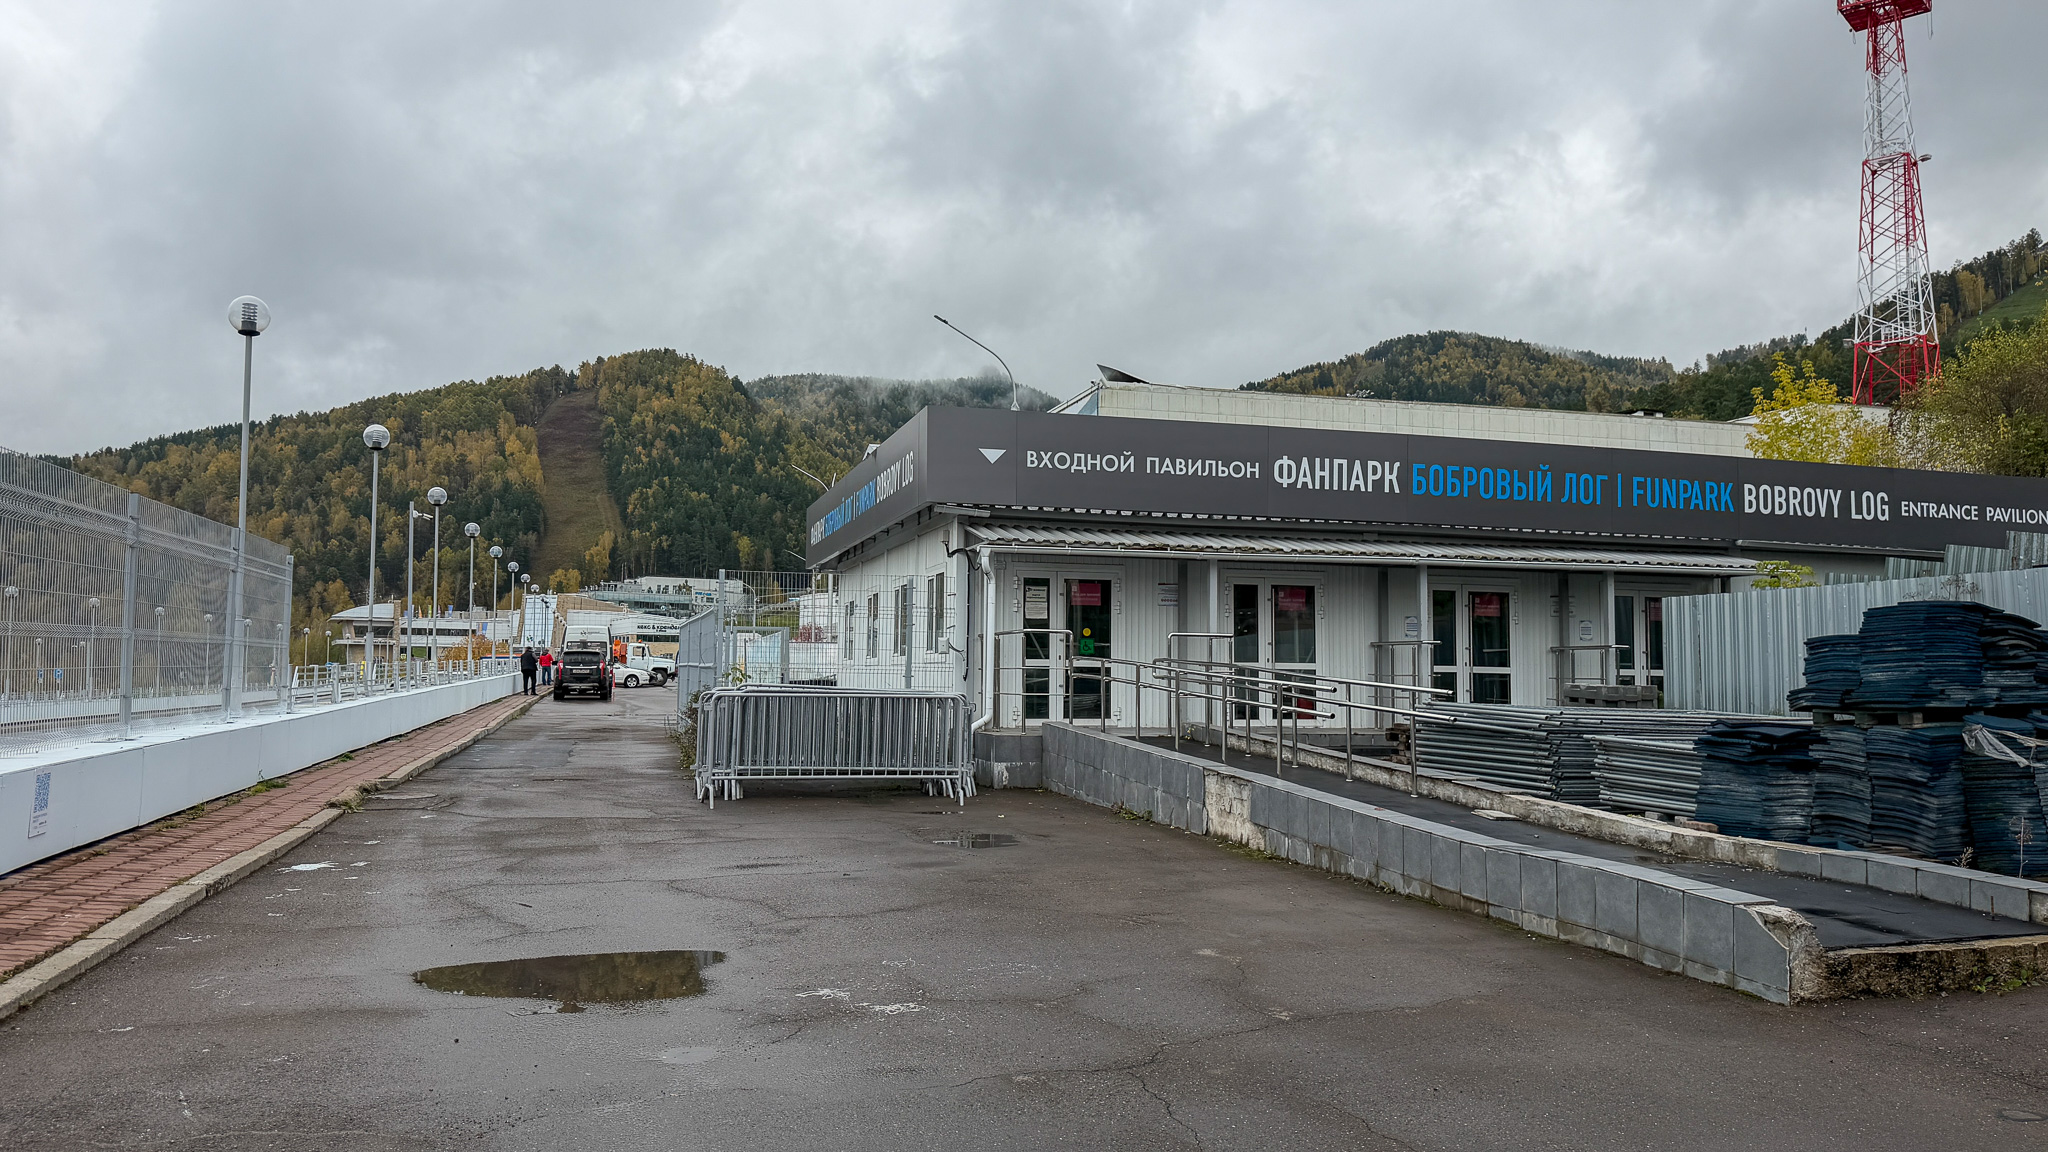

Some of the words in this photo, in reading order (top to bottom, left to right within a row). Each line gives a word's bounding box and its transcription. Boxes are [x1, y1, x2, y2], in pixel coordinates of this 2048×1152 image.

[877, 460, 901, 504] BOBROVY
[902, 451, 914, 488] LOG
[1026, 450, 1135, 474] ВХОДНОЙ
[1146, 456, 1260, 479] ПАВИЛЬОН
[1273, 455, 1401, 494] ФАНПАРК
[1412, 463, 1552, 503] БОБРОВЫЙ
[1560, 472, 1609, 506] ЛОГ
[1632, 476, 1735, 513] FUNPARK
[1743, 483, 1842, 519] BOBROVY
[1850, 490, 1889, 522] LOG
[1901, 500, 1979, 521] ENTRANCE
[1986, 506, 2048, 525] PAVILION
